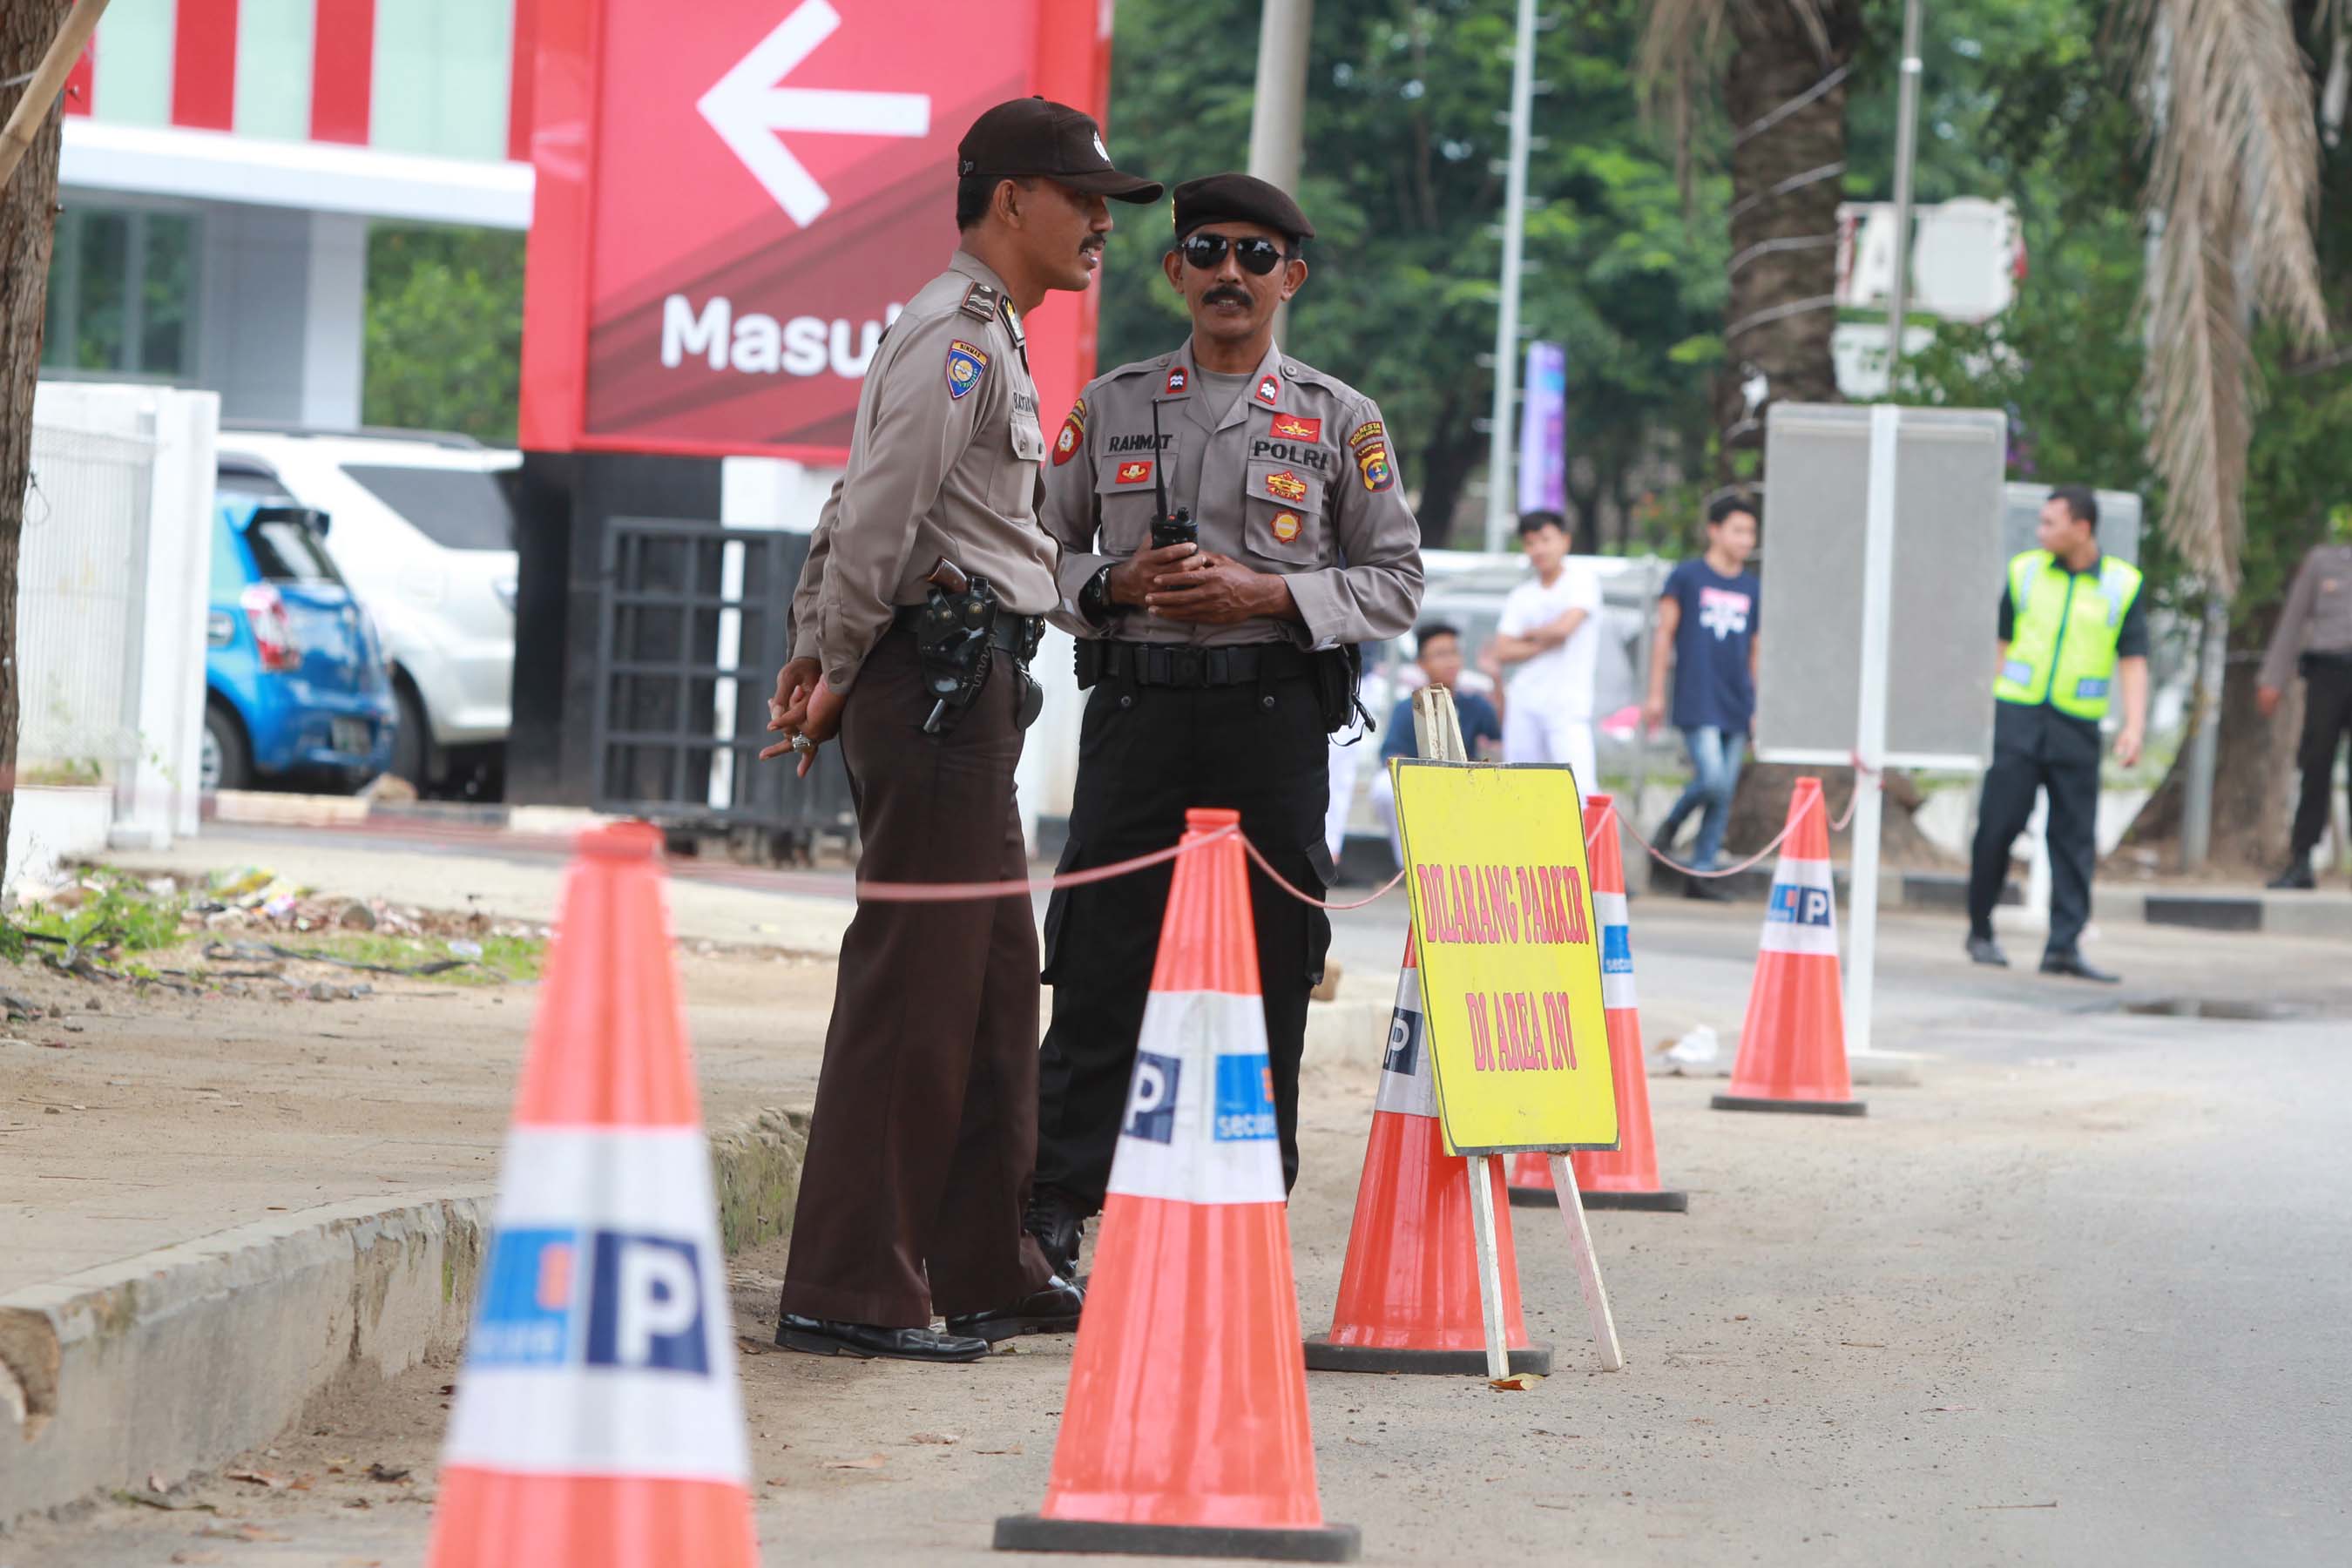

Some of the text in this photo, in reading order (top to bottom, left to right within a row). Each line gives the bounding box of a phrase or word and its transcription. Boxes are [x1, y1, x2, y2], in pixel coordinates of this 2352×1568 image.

[1109, 434, 1173, 452] RAHMAT
[1254, 441, 1328, 470] POLRI
[1417, 864, 1589, 944] DILARANG PARKIR
[1806, 891, 1827, 923] P
[1384, 1019, 1410, 1067] P
[1465, 992, 1577, 1071] DI AREA INI
[1125, 1061, 1165, 1132] P
[616, 1241, 697, 1363] P
